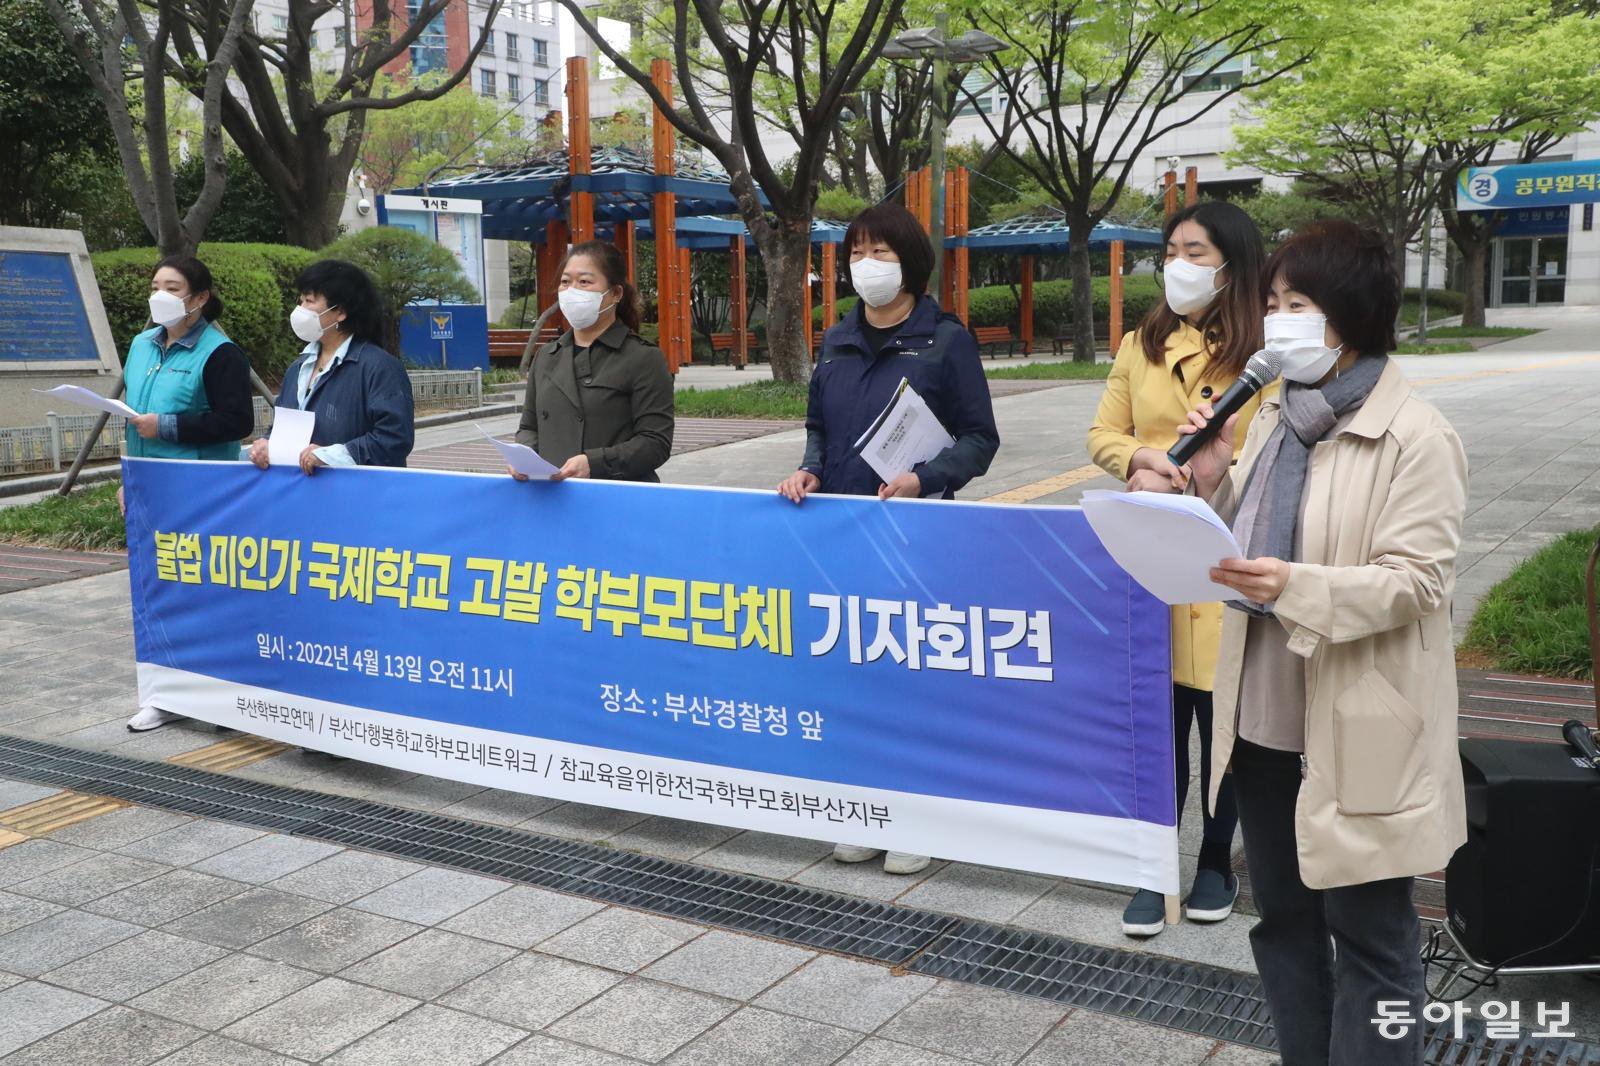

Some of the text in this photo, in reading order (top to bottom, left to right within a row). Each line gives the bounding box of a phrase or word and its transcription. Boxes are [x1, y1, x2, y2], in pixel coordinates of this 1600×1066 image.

[421, 198, 448, 210] 게시판
[1474, 178, 1491, 197] 경
[1515, 173, 1600, 196] 공무원직
[154, 530, 1054, 682] 불법 미인가 국제학교 고발 학부모단체 기자회견
[257, 632, 286, 661] 일시
[296, 640, 349, 672] 2022년
[352, 649, 379, 677] 4월
[384, 654, 422, 683] 13일
[428, 659, 465, 690] 오전
[471, 667, 514, 697] 11시
[600, 683, 646, 714] 장소
[664, 692, 788, 737] 부산경찰청
[797, 711, 824, 742] 앞
[236, 695, 315, 733] 부산학부모연대
[329, 715, 538, 773] 부산다행복학교학부모네트워크
[560, 756, 892, 829] 참교육을위한전국학부모회부산지부
